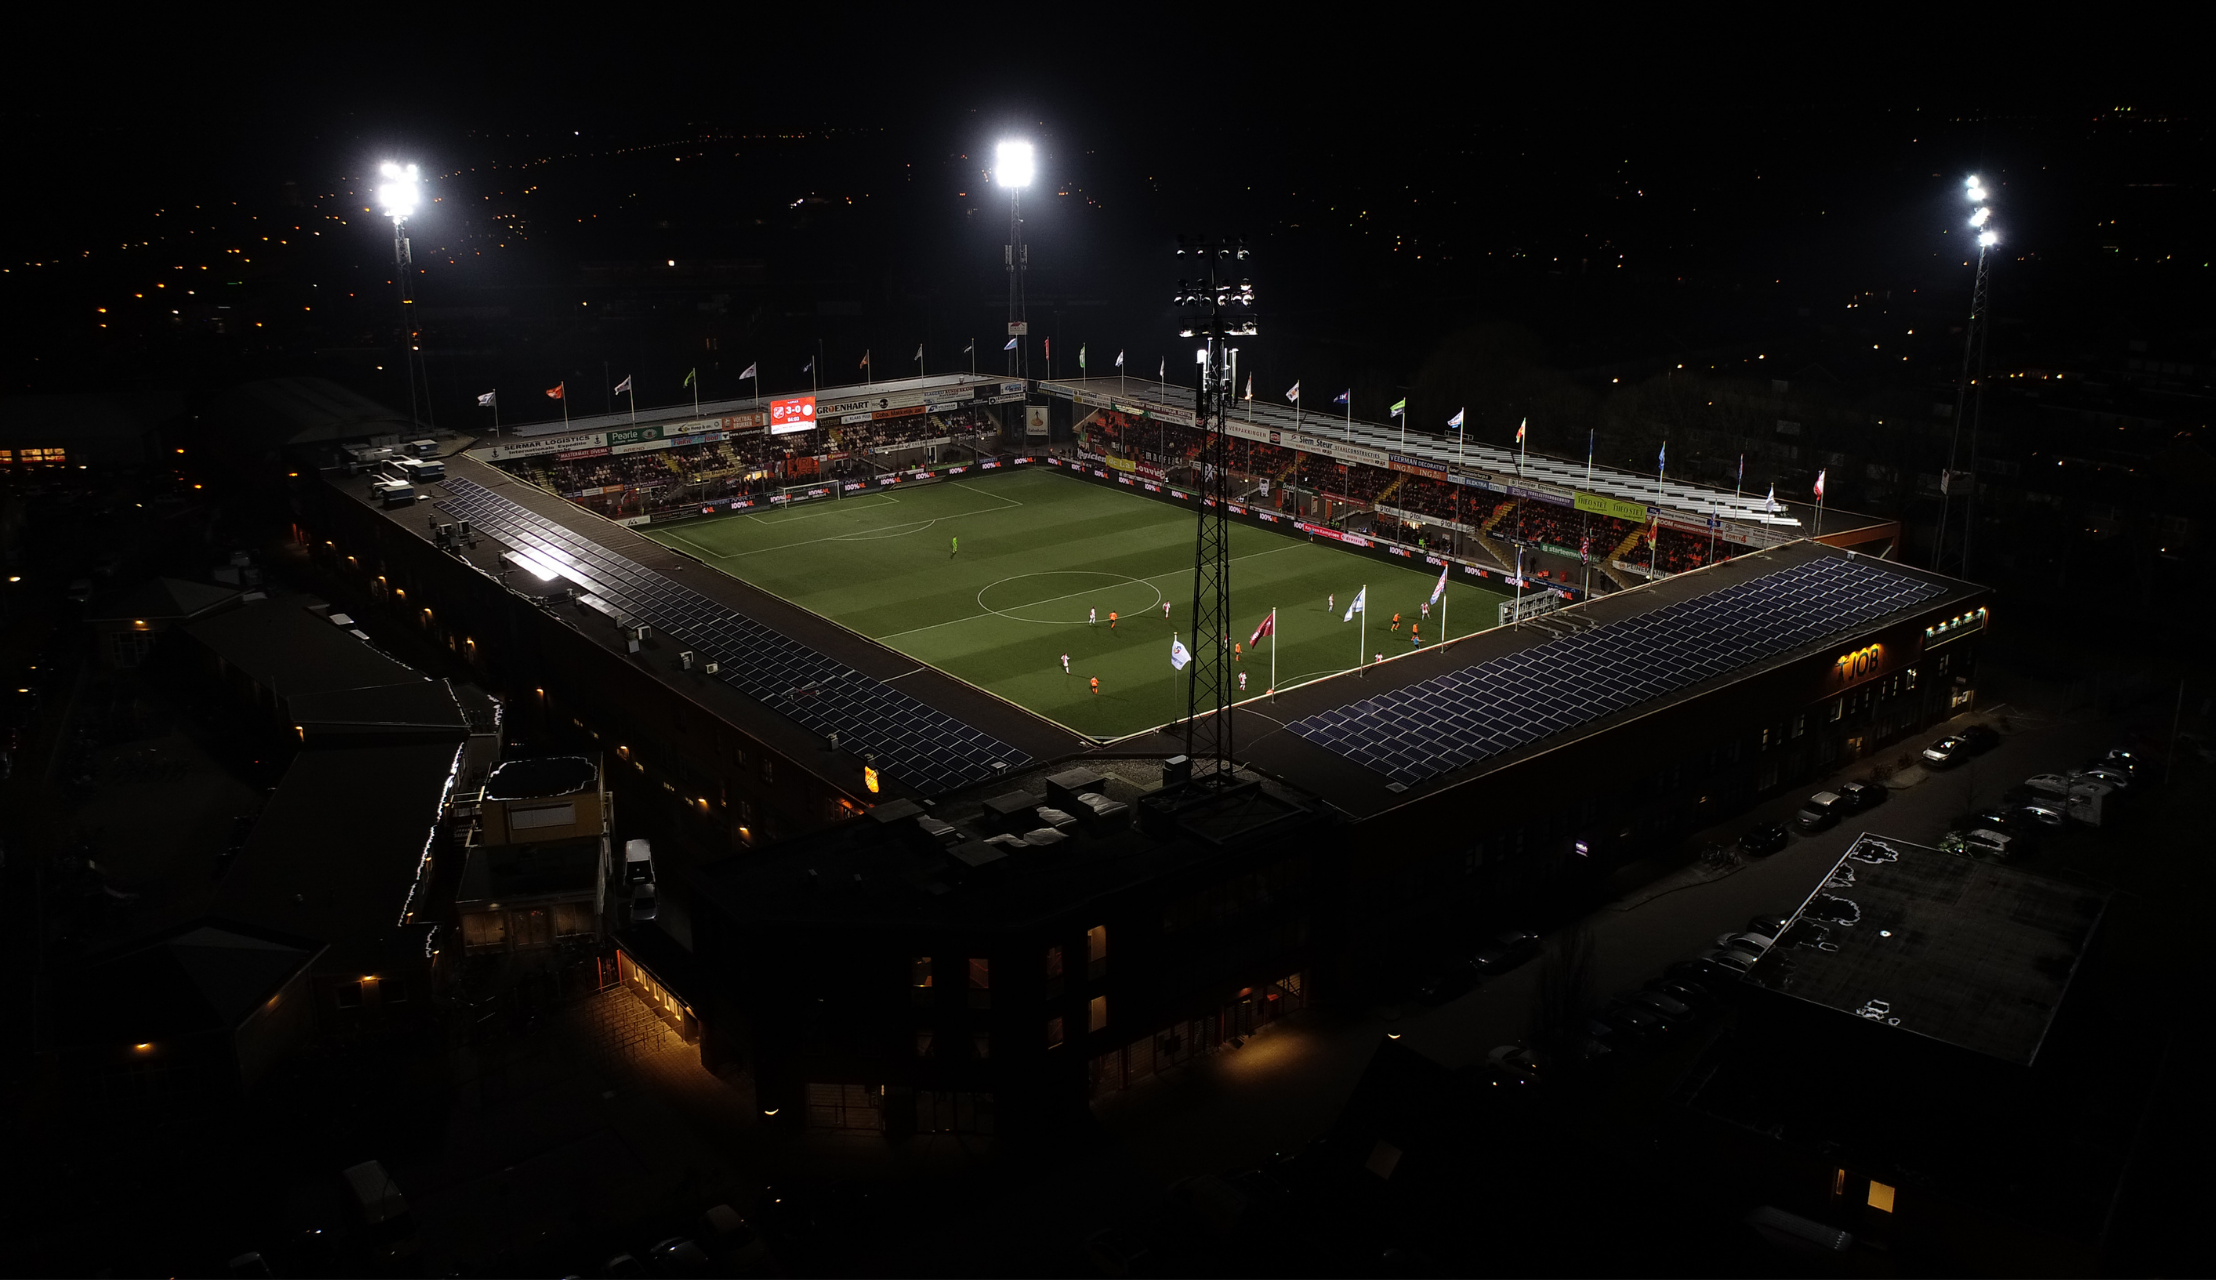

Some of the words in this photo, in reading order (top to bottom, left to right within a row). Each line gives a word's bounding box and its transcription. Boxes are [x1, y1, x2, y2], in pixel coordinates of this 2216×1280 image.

[786, 405, 801, 414] 3-0
[816, 401, 869, 414] GROENHART
[612, 430, 638, 440] Pearle
[1229, 426, 1266, 437] VERPAKKINGEN
[505, 442, 541, 451] SERMAR
[545, 435, 590, 445] LOGISTICS
[1316, 439, 1333, 448] Steur
[1119, 459, 1130, 468] La
[1390, 454, 1418, 466] VEERMAN
[1418, 460, 1446, 472] DECORATIEF
[916, 471, 936, 480] 100%NL
[1393, 464, 1406, 472] ING
[1419, 469, 1432, 478] ING
[844, 482, 866, 491] 100%NL
[731, 500, 754, 509] 100%NL
[1259, 512, 1278, 523] 100%NL
[1658, 519, 1673, 527] ROOM
[1389, 546, 1411, 558] 100%NL
[1465, 566, 1489, 578] 100%NL
[1849, 648, 1879, 681] JOB
